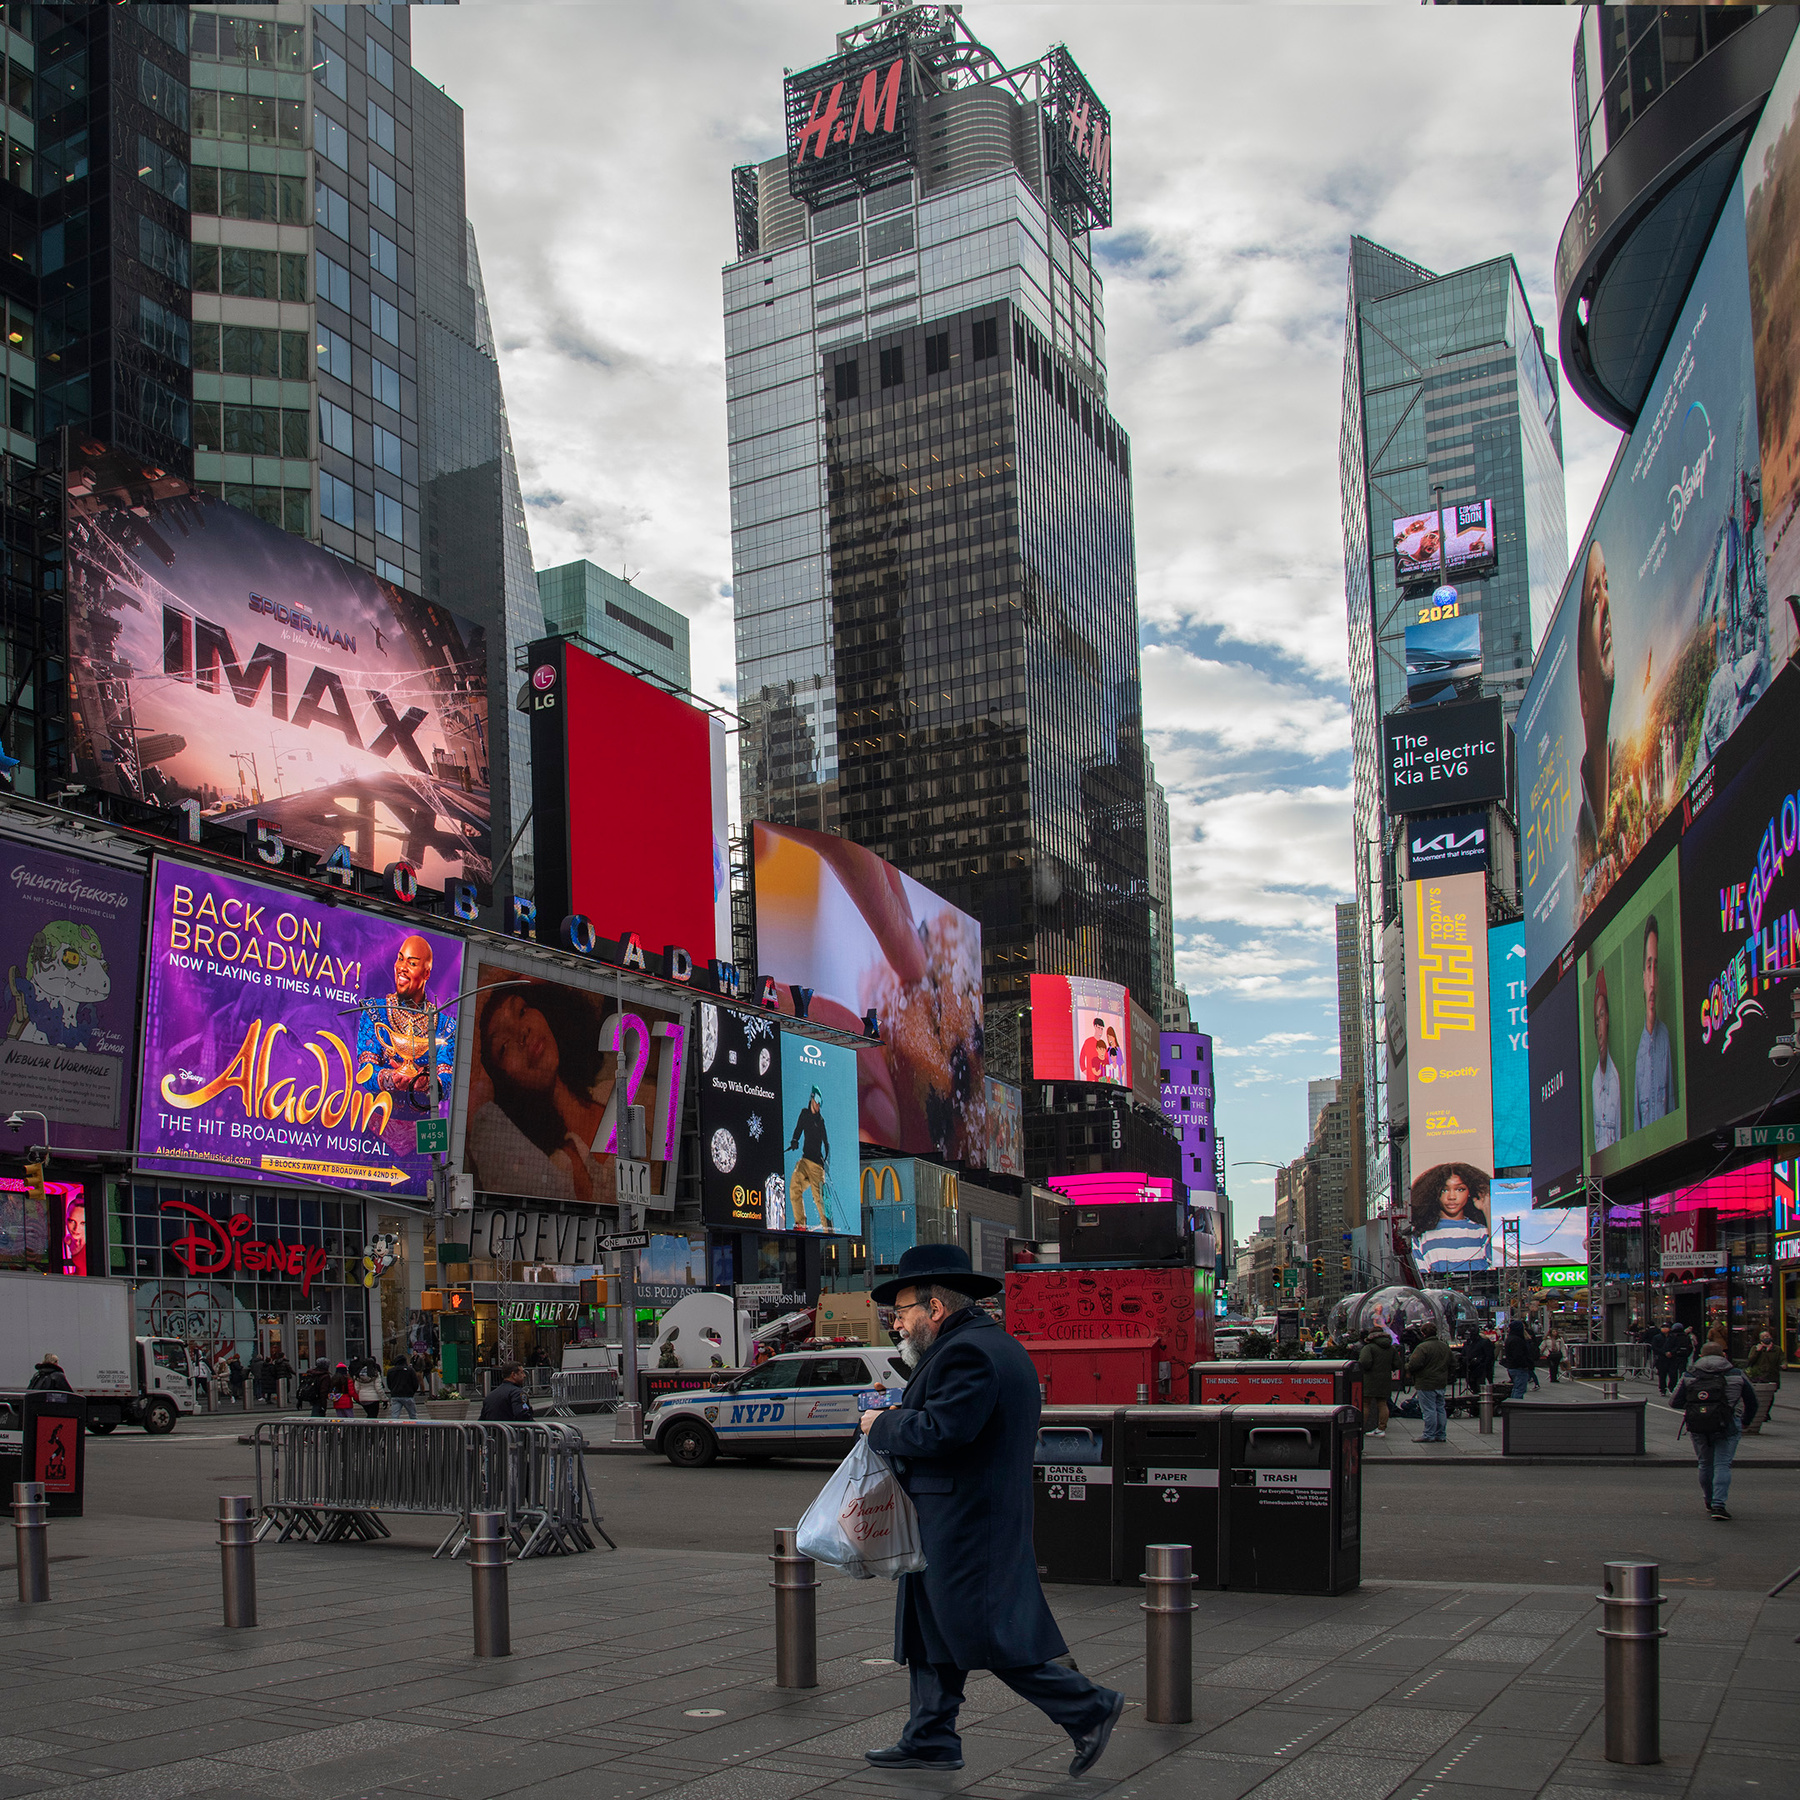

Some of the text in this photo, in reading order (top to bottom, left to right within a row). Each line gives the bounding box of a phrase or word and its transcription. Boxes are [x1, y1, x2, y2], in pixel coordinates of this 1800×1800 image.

[796, 59, 904, 164] H&M
[1069, 92, 1110, 193] H&M
[1692, 303, 1708, 340] THE
[1679, 355, 1696, 395] THIS
[1458, 503, 1482, 514] COMING
[1459, 510, 1483, 526] SOON
[1418, 603, 1460, 624] 2021
[281, 629, 332, 654] No Way Home
[163, 603, 432, 774] IMAX
[534, 694, 555, 711] LG
[1391, 734, 1428, 751] The
[1393, 741, 1496, 769] all-electric
[1394, 761, 1469, 786] Kia EV6
[1691, 764, 1716, 800] MARRIOTT
[1692, 785, 1714, 818] MARQUIS
[1413, 852, 1446, 863] Movement
[1447, 850, 1460, 859] that
[1720, 789, 1800, 944] WE BELO
[66, 866, 80, 875] VISIT
[33, 896, 44, 904] NFT
[46, 899, 67, 909] SOCIAL
[68, 904, 101, 917] ADVENTURE
[102, 911, 116, 920] CLUB
[172, 884, 322, 949] BACK ON
[1430, 887, 1443, 939] TODAY'S
[1443, 915, 1455, 940] TOP
[1455, 912, 1467, 941] HITS
[170, 918, 362, 990] BROADWAY!
[169, 953, 359, 1006] NOW PLAYING 8 TIMES A WEEK
[96, 1038, 126, 1054] ARMOR
[5, 1049, 111, 1077] NEBULAR WORMHOLE
[799, 1055, 827, 1068] OAKLEY
[160, 1018, 393, 1136] Aladdin
[179, 1068, 205, 1084] Disney
[1439, 1066, 1480, 1079] Spotify
[590, 1012, 685, 1162] 21
[712, 1076, 775, 1100] Shop With Confidence
[1160, 1084, 1212, 1098] ATALYSTS
[1541, 1070, 1564, 1103] PASSION
[1163, 1099, 1205, 1110] OF THE
[427, 1122, 437, 1130] TO
[1112, 1109, 1121, 1150] 1500
[1425, 1116, 1460, 1129] SZA
[1442, 1128, 1477, 1136] STREAMING
[158, 1113, 391, 1157] THE HIT BROADWAY MUSICAL
[1754, 1127, 1796, 1144] W 46
[275, 1160, 300, 1170] BLOCKS
[302, 1163, 320, 1172] AWAY
[322, 1165, 331, 1173] AT
[331, 1165, 367, 1177] BROADWAY
[374, 1170, 392, 1179] 42ND
[747, 1188, 762, 1206] IGI
[469, 1208, 607, 1265] FOREVER
[604, 1236, 643, 1247] ONE WAY
[1545, 1270, 1586, 1283] YORK
[637, 1286, 653, 1298] U.S.
[654, 1286, 679, 1299] POLO
[793, 1291, 807, 1305] hut
[566, 1303, 580, 1321] 21
[1056, 1323, 1141, 1340] COFFEE & TEA
[651, 1379, 678, 1389] ain't
[730, 1403, 785, 1424] NYPD
[1154, 1473, 1188, 1481] PAPER
[1262, 1473, 1298, 1482] TRASH
[841, 1493, 895, 1518] Thank
[853, 1520, 892, 1541] You
